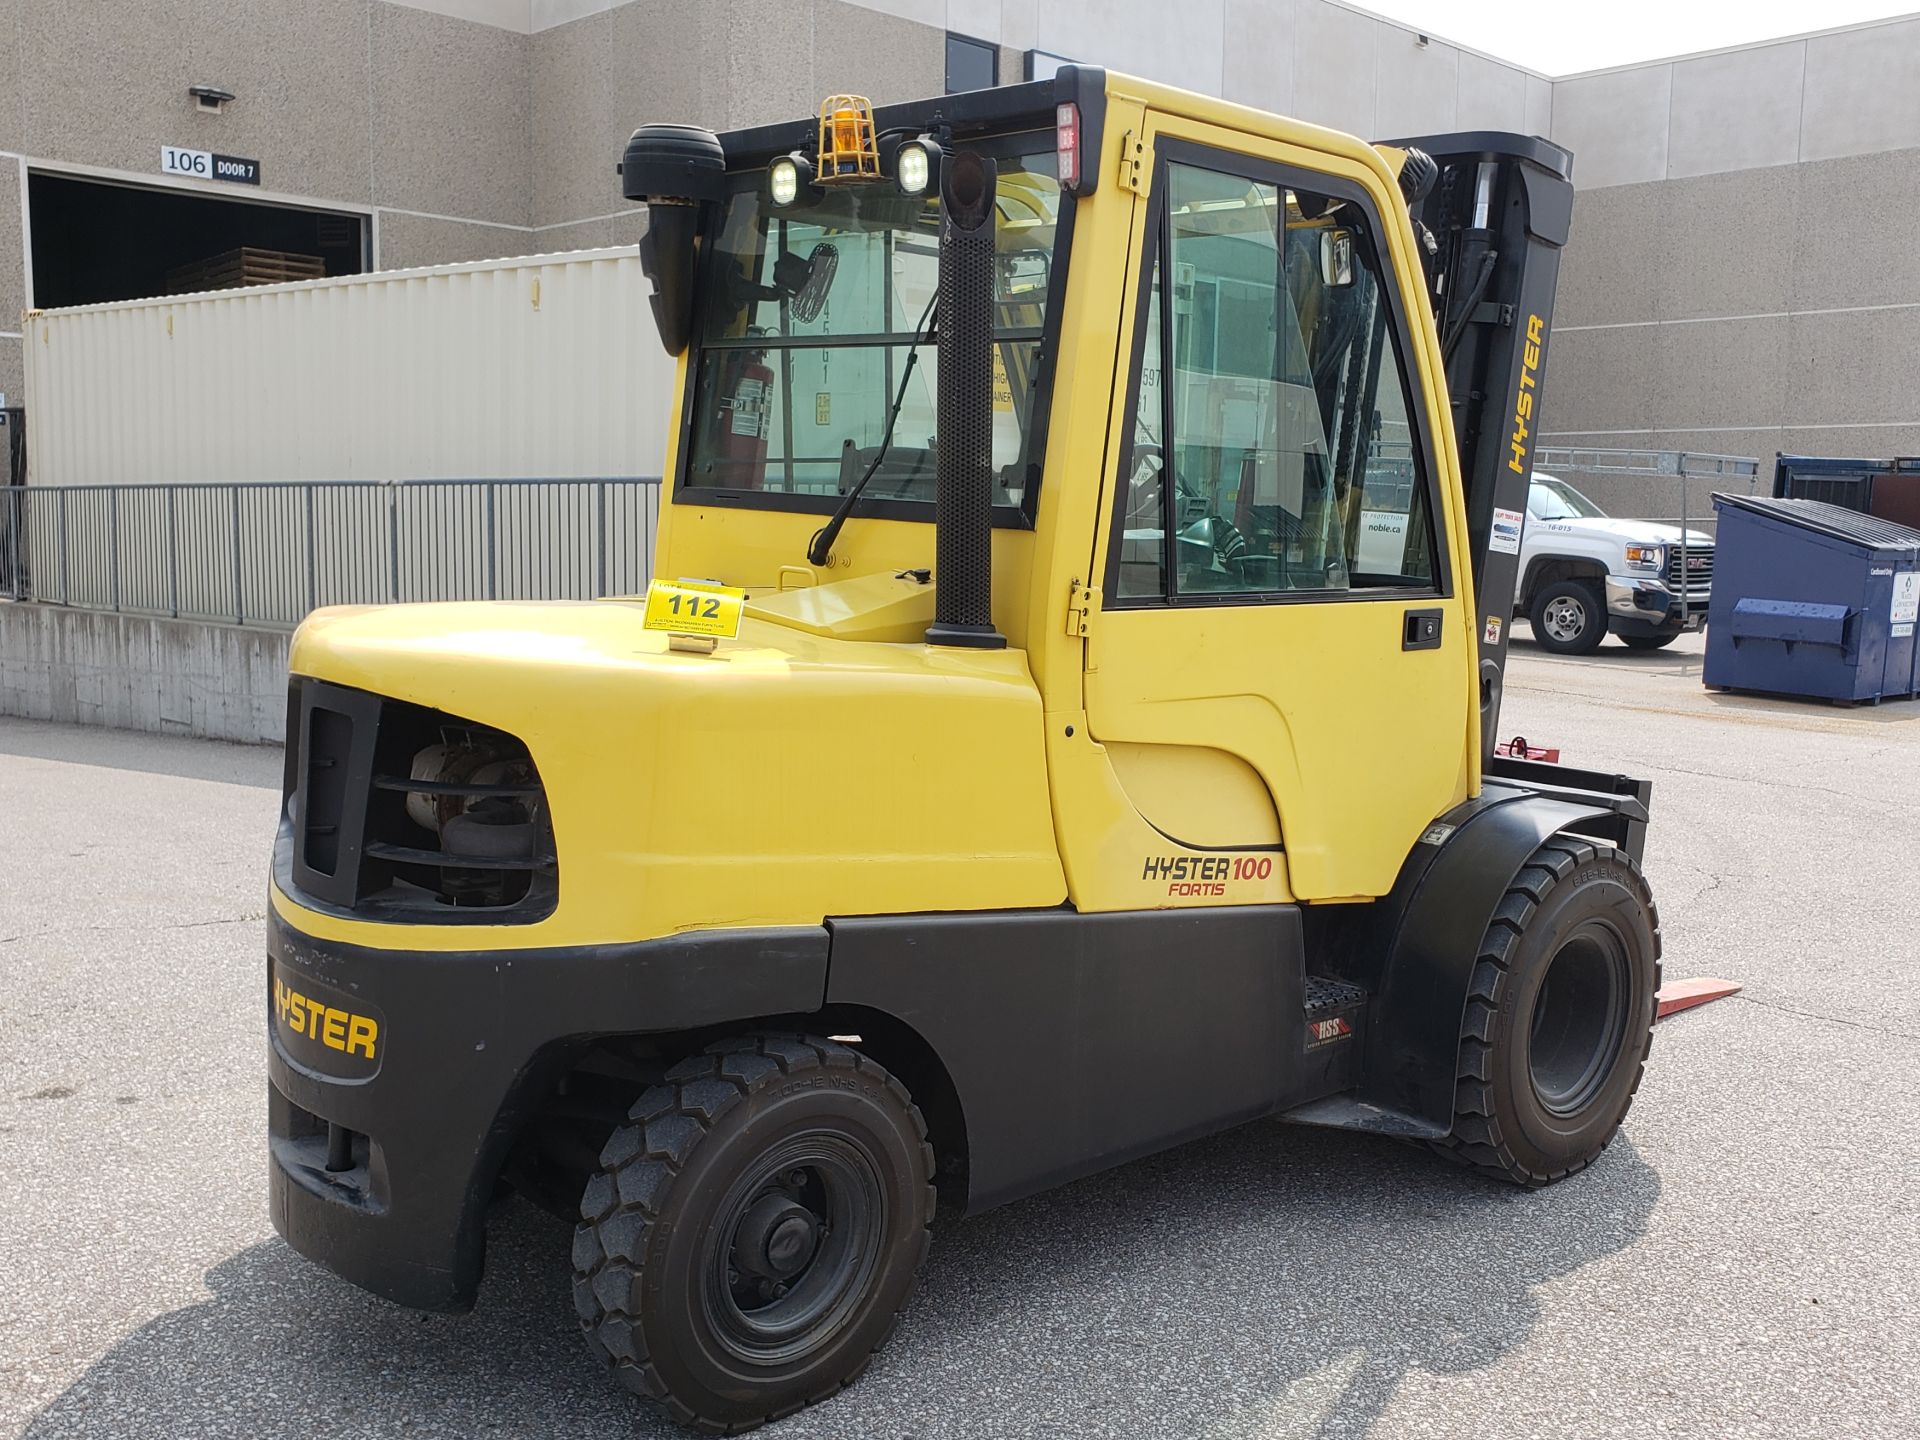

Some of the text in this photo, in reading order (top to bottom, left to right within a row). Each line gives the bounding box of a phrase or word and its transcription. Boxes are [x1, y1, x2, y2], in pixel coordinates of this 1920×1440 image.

[167, 150, 254, 178] 106 DOOR 7
[1508, 313, 1544, 475] HYSTER
[1368, 523, 1401, 534] noble.ca
[668, 594, 721, 619] 112
[1142, 856, 1272, 880] HYSTER 100
[1168, 883, 1225, 896] FORTIS
[1318, 1017, 1340, 1040] HSS
